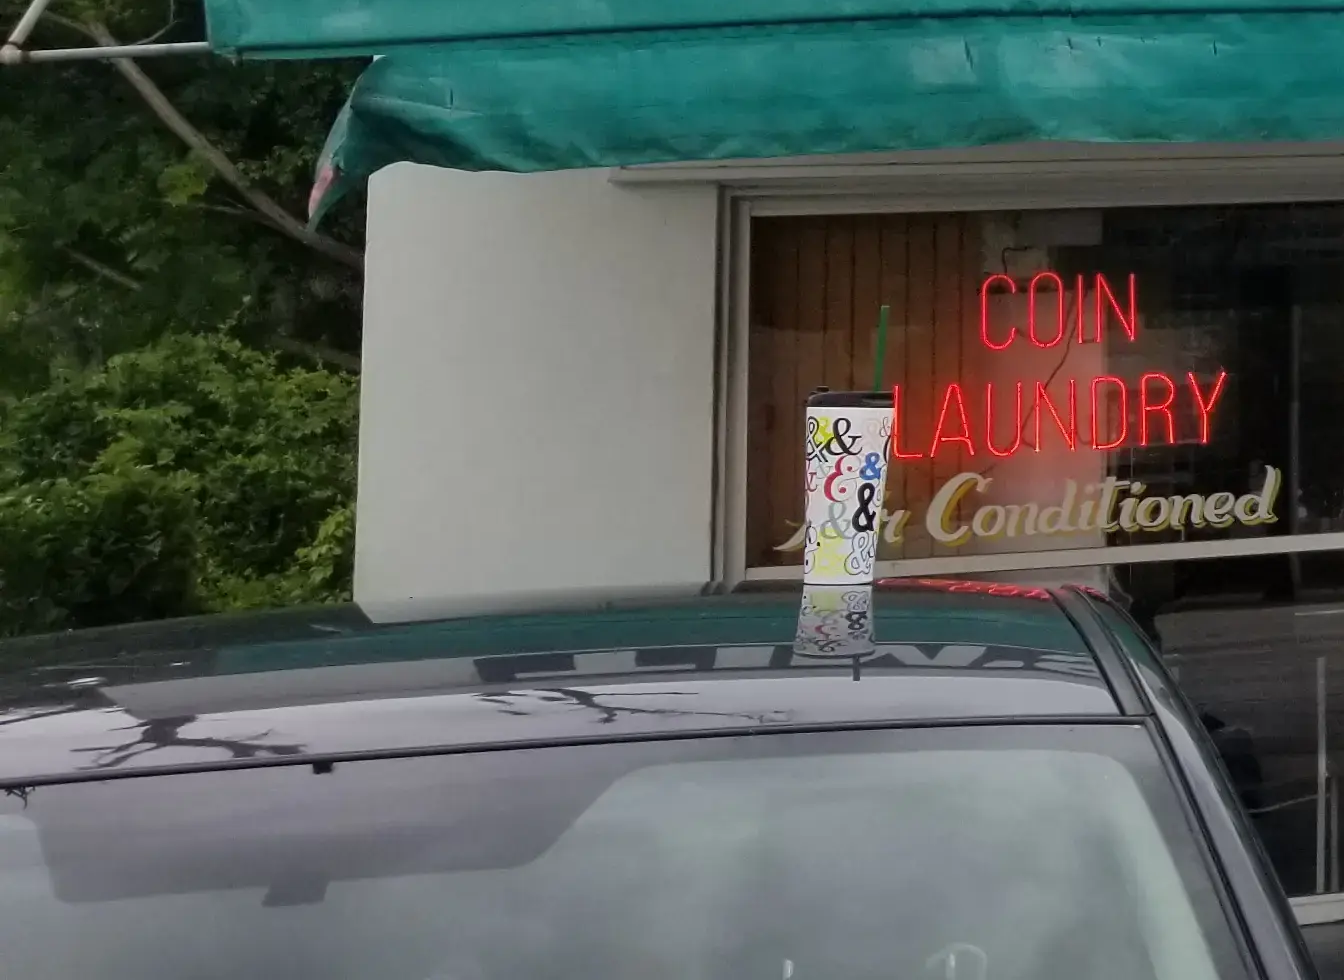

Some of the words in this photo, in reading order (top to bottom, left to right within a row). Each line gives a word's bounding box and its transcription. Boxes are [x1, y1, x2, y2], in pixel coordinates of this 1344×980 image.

[980, 271, 1136, 350] COIN
[890, 370, 1228, 459] LAUNDRY
[925, 465, 1283, 548] Conditioned
